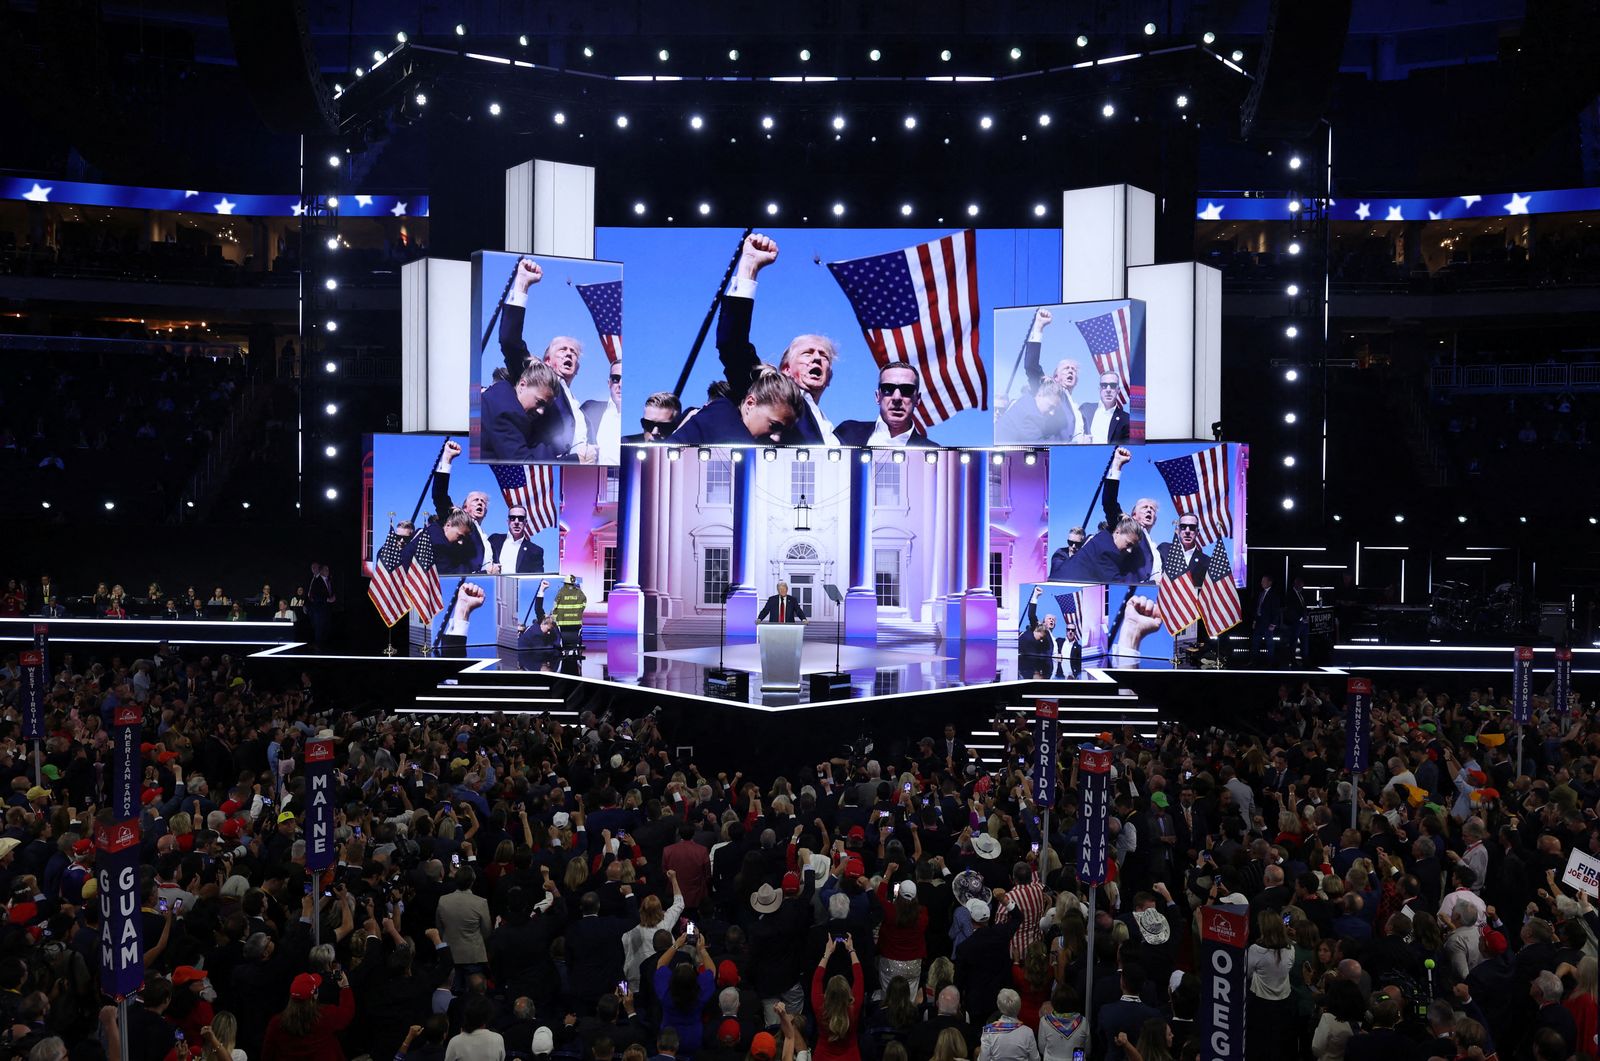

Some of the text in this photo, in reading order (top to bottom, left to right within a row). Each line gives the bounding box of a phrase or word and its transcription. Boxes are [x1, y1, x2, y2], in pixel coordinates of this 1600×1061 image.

[1310, 612, 1332, 623] TRUMP
[29, 691, 38, 735] VIRGINIA
[1522, 661, 1530, 720] WISCONSIN
[1038, 720, 1050, 801] FLORIDA
[1352, 694, 1362, 769] PENNSYLVANIA
[123, 783, 131, 817] SAMOA
[312, 774, 327, 854] MAINE
[1081, 775, 1093, 876] INDIANA
[1098, 775, 1107, 877] INDIANA
[1568, 868, 1598, 887] JOE BID
[100, 868, 114, 971] GUAM
[118, 866, 138, 971] GUAM
[1210, 949, 1233, 1061] OREG
